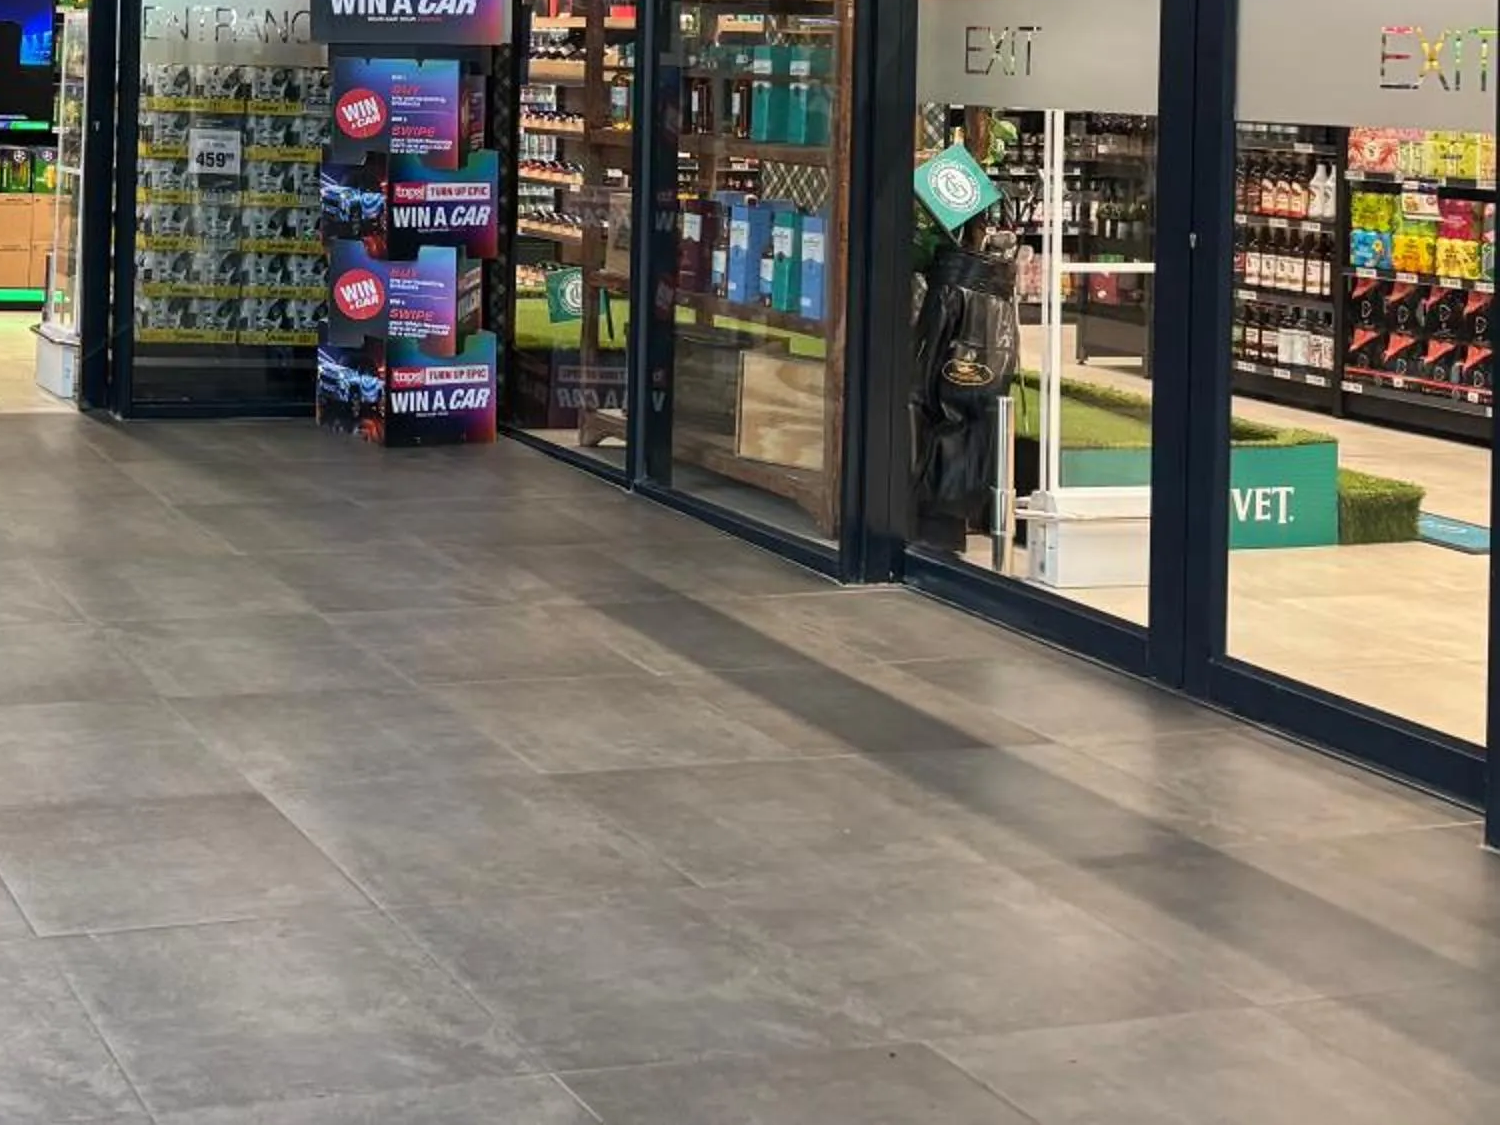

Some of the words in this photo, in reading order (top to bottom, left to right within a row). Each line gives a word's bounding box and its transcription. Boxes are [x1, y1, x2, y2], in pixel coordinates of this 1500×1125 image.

[144, 6, 311, 44] ENTRANC
[965, 26, 1042, 76] EXIT
[1380, 26, 1497, 92] EXIT
[341, 96, 380, 122] WIN
[393, 206, 430, 228] WIN
[433, 206, 447, 227] A
[450, 205, 491, 226] CAR
[340, 279, 377, 303] WIN
[391, 391, 429, 413] WIN
[432, 390, 446, 410] A
[449, 388, 490, 410] CAR
